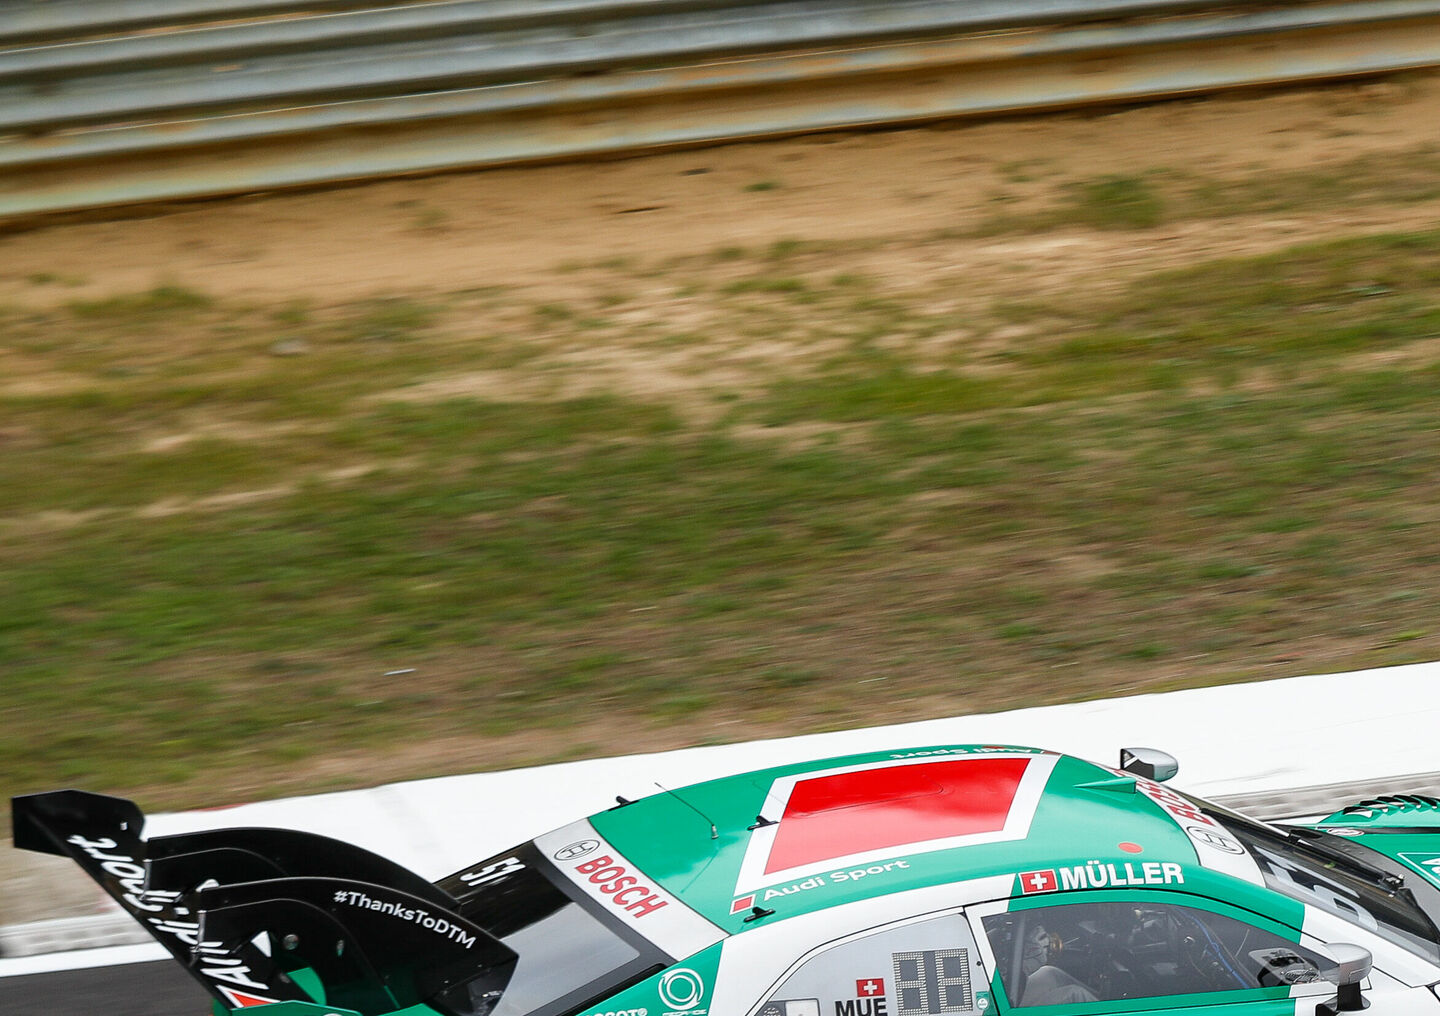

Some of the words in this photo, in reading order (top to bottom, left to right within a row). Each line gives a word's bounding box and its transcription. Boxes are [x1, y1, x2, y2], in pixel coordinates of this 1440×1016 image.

[460, 856, 526, 886] 51
[575, 855, 669, 918] BOSCH
[763, 875, 824, 901] Audi
[830, 859, 910, 887] Sport
[1060, 859, 1185, 890] MÜLLER
[334, 890, 477, 949] #ThanksToDTM
